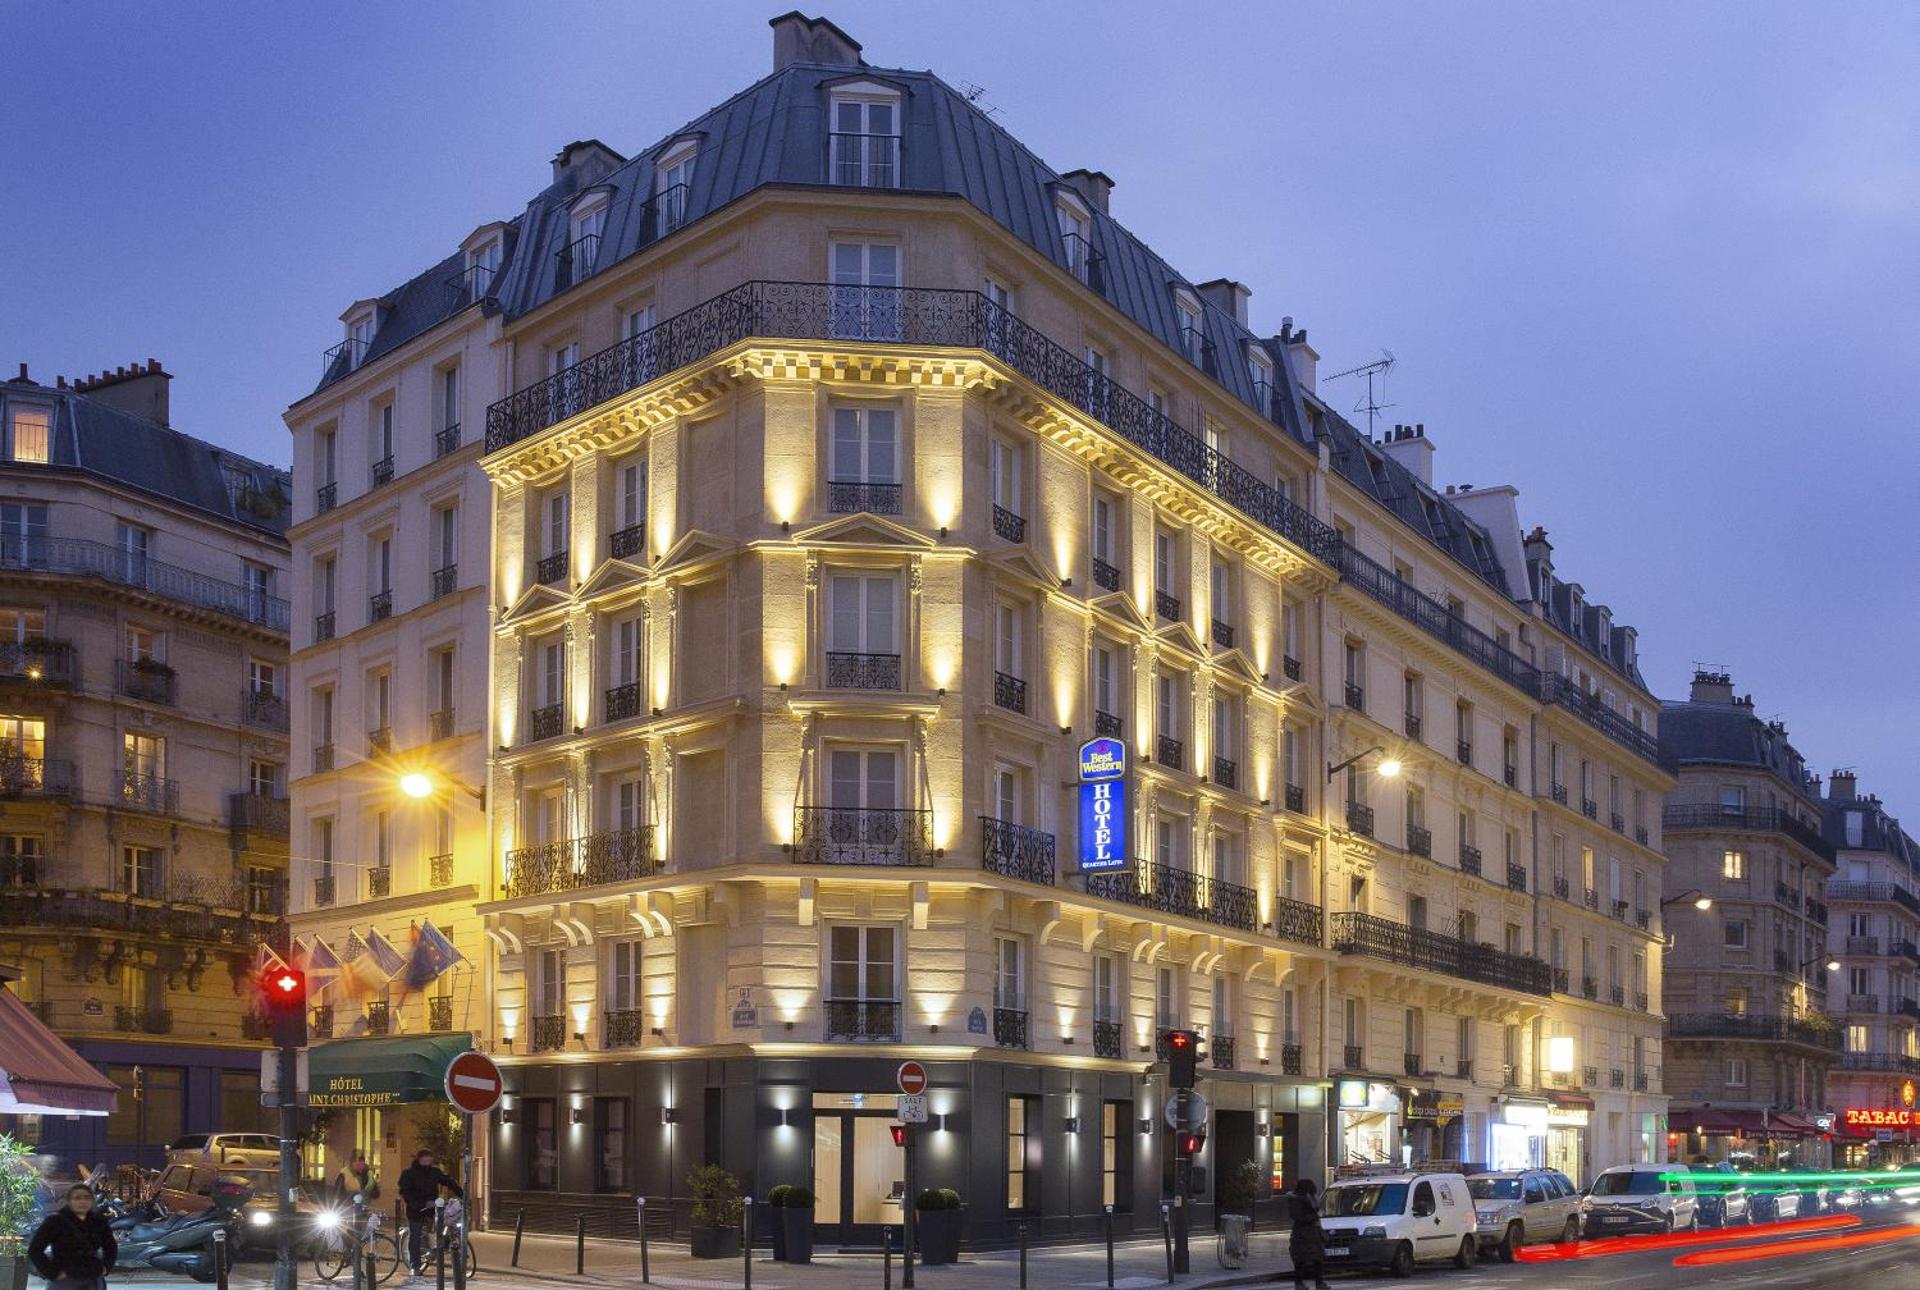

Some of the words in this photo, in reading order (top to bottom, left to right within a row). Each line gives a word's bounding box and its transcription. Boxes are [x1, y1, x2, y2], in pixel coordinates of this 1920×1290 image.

[1091, 751, 1113, 763] Best
[1083, 761, 1122, 773] Western
[1093, 783, 1111, 860] HOTEL
[330, 1076, 363, 1090] HÔTEL
[330, 1092, 391, 1105] CHRISTOPHE
[1847, 1110, 1909, 1125] TABAC
